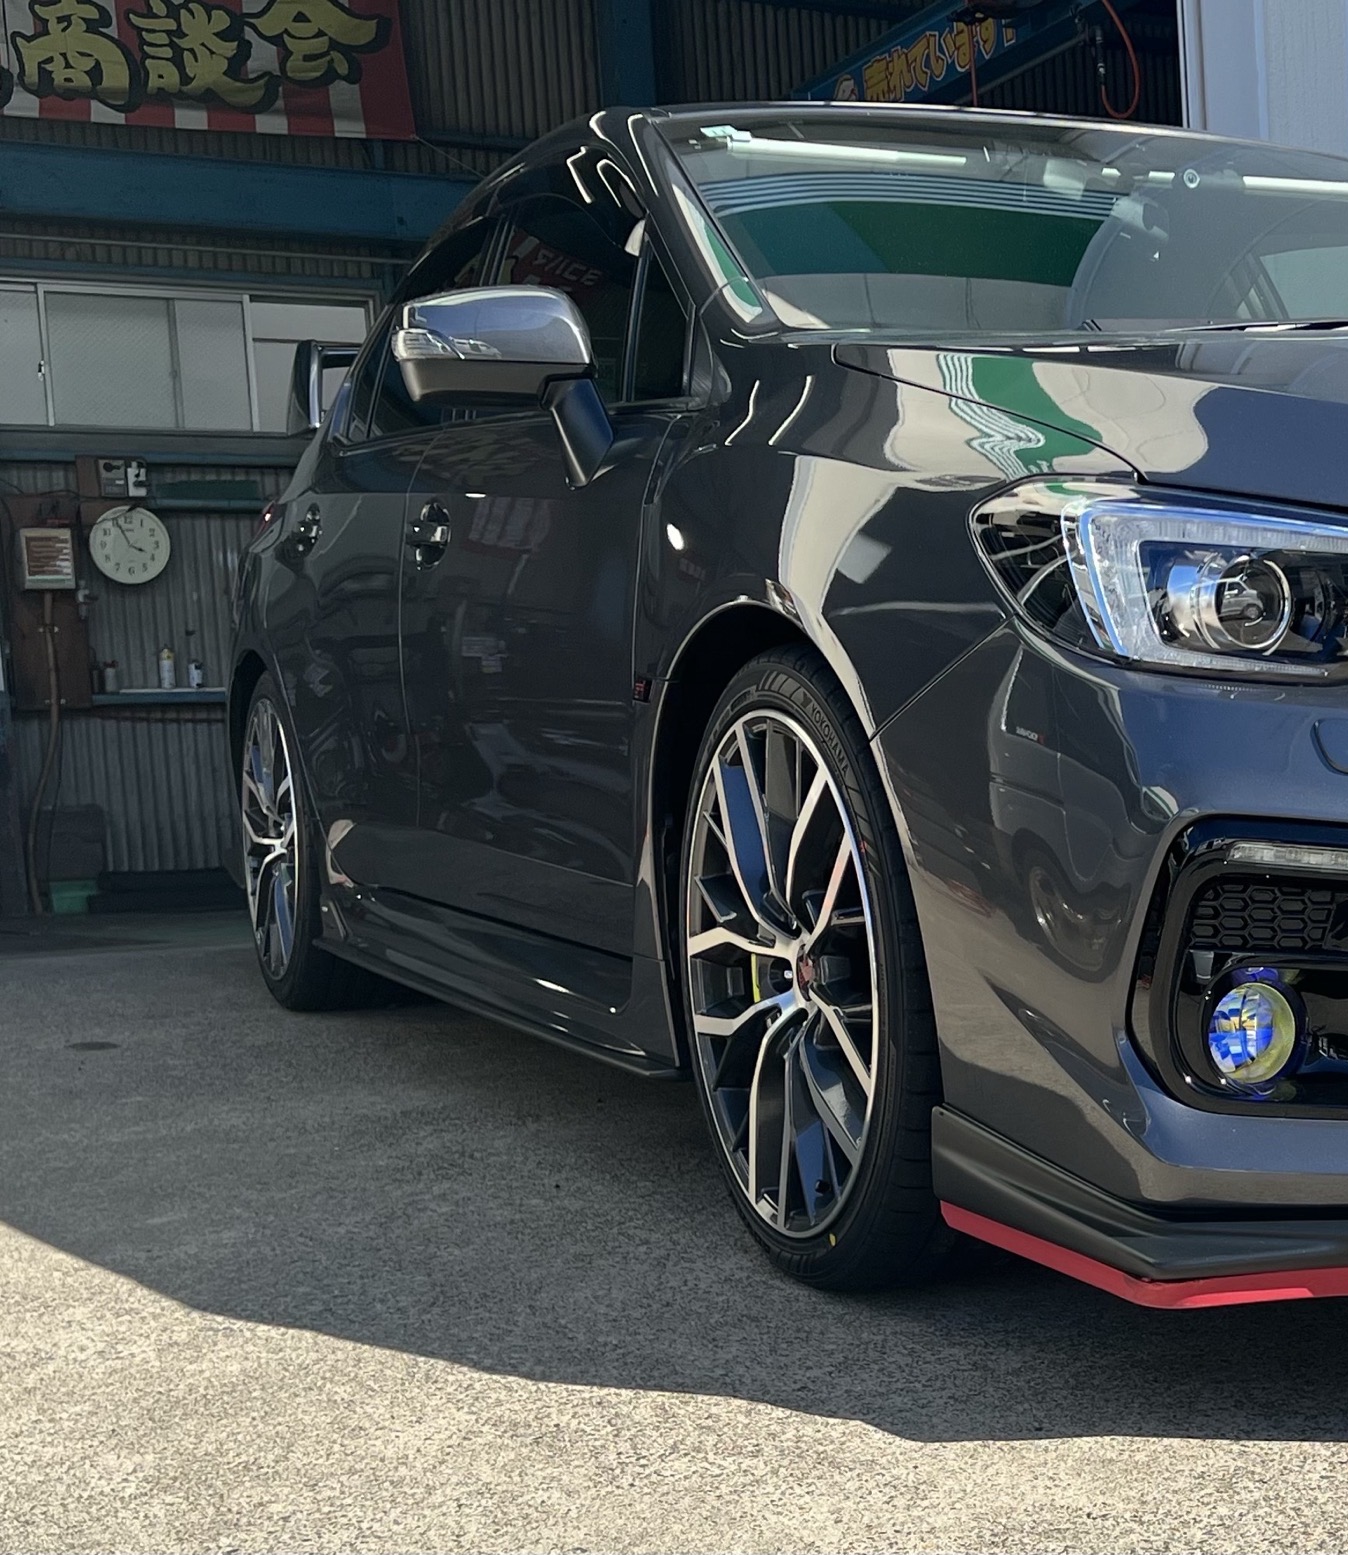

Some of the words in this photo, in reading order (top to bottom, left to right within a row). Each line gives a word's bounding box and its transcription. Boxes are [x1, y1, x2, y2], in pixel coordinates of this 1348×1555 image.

[12, 0, 390, 112] 商談会
[810, 703, 850, 778] YOKOHAMA
